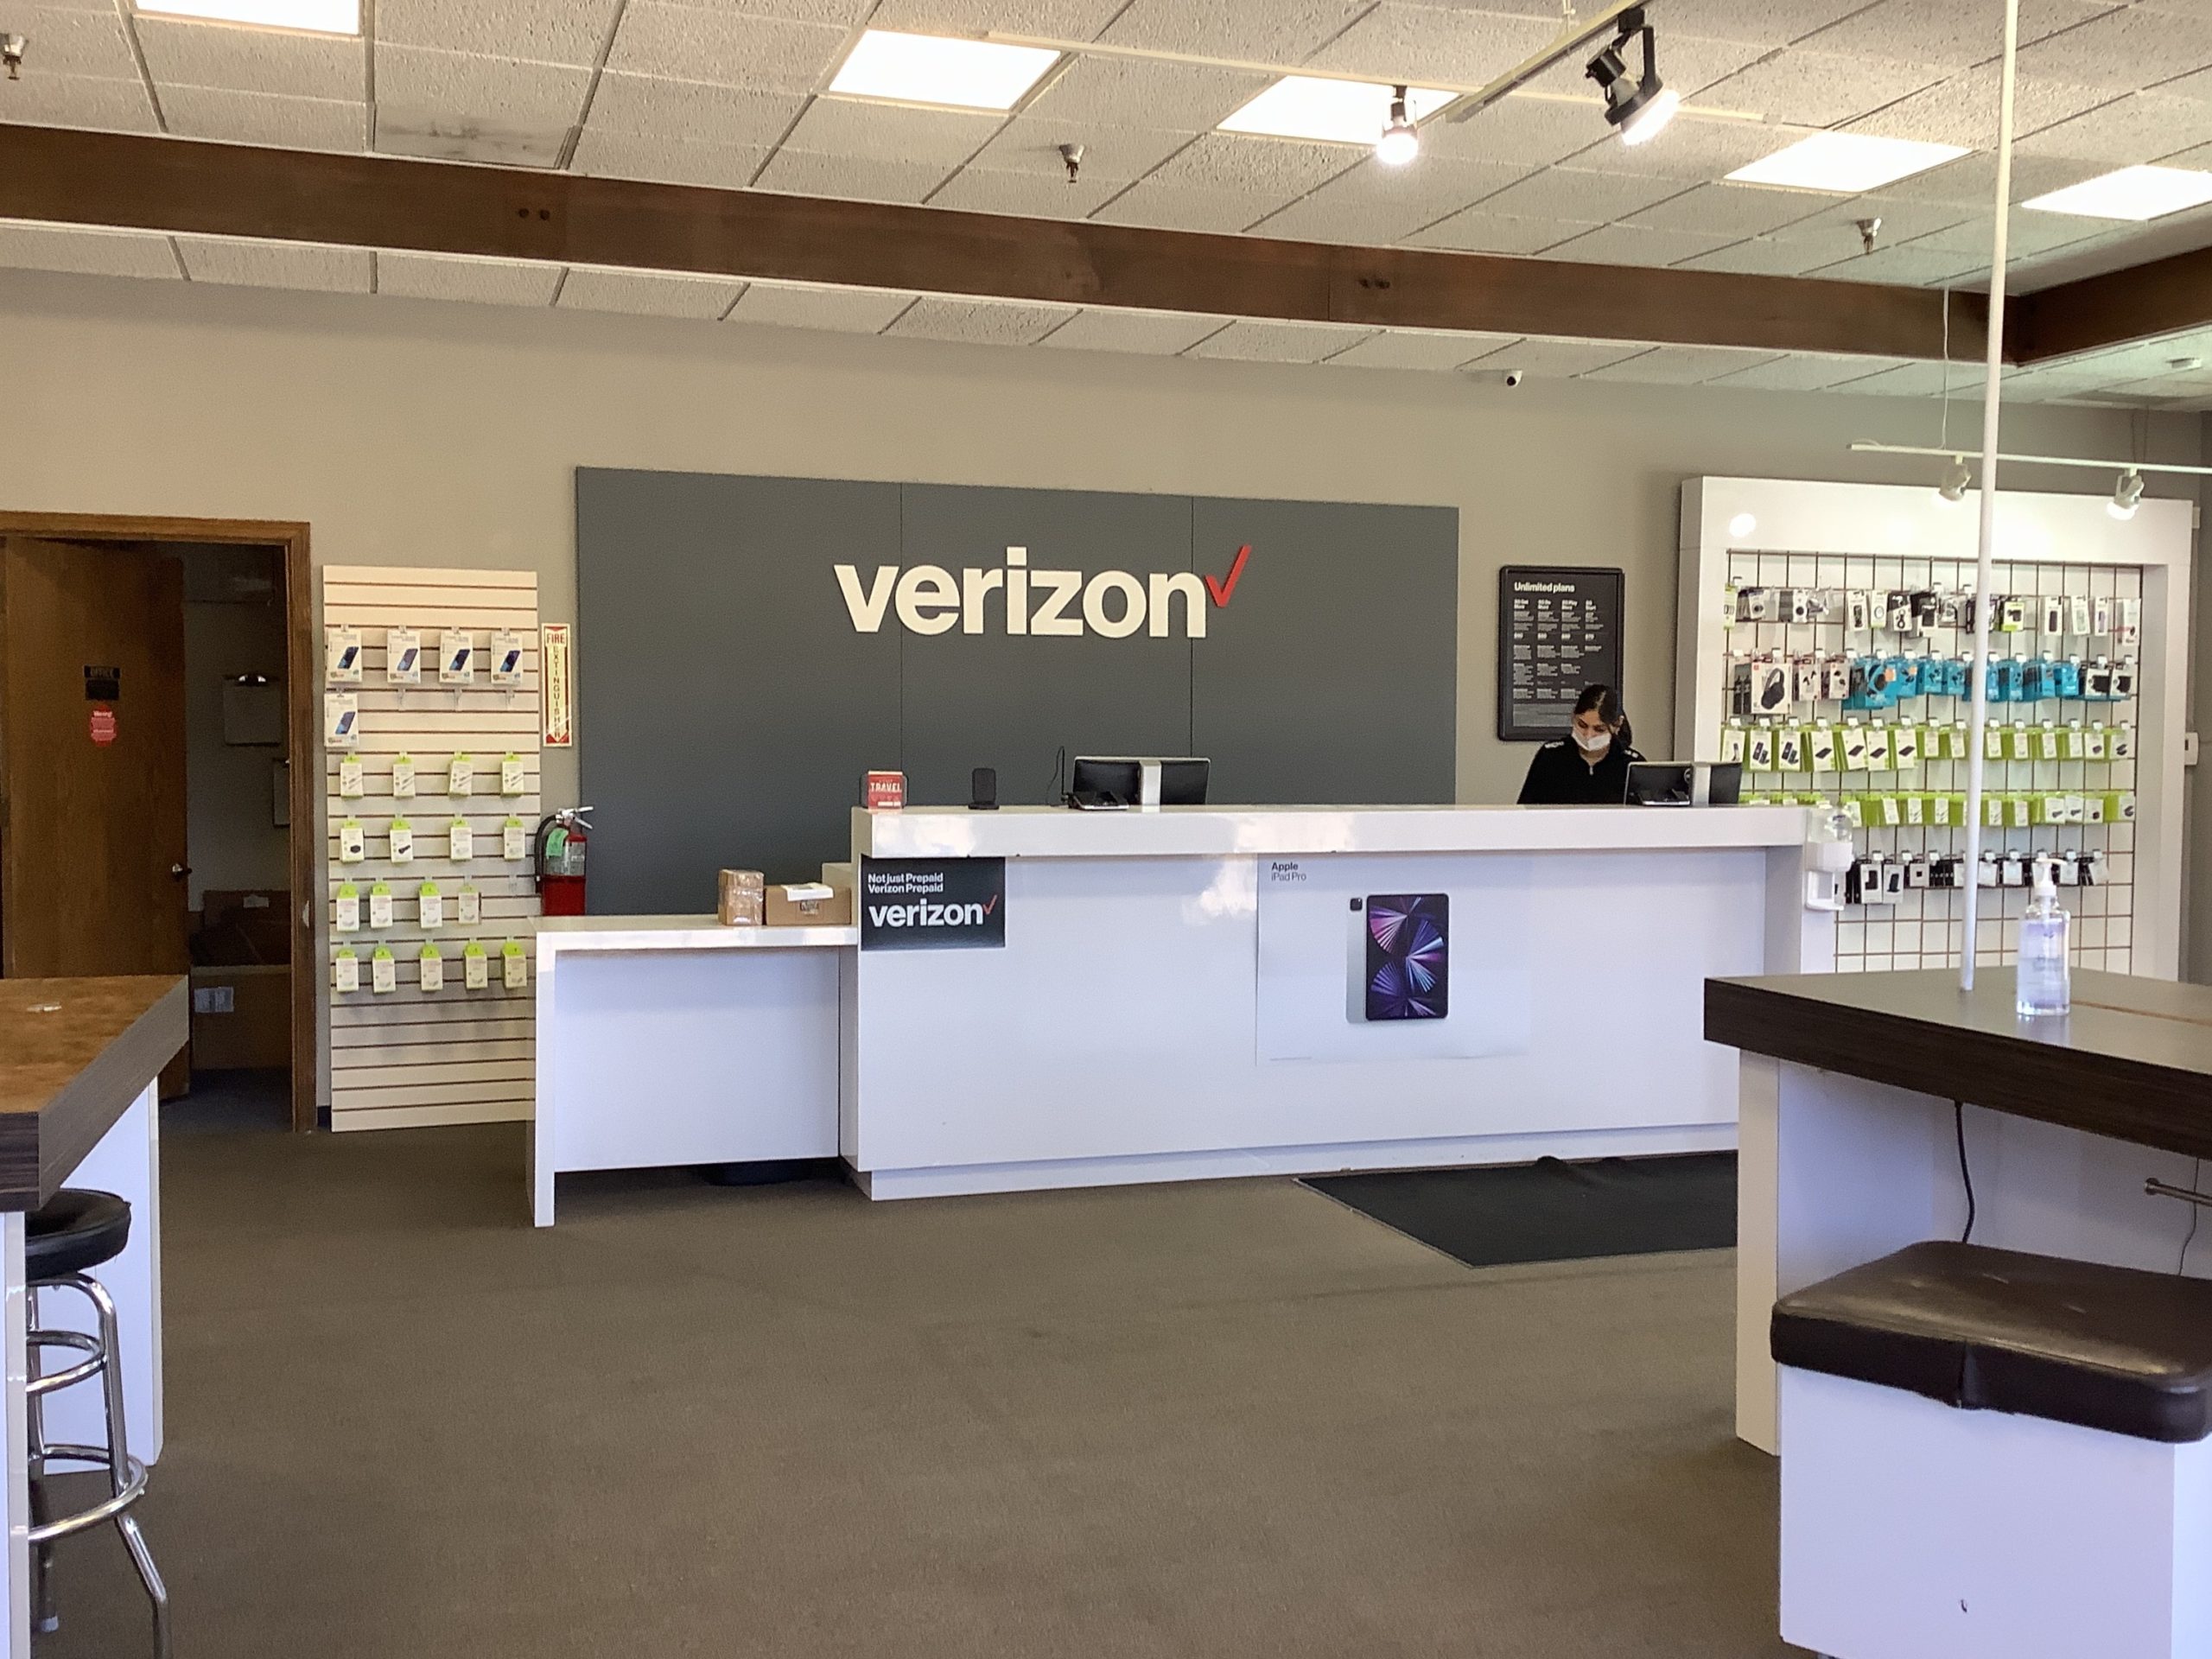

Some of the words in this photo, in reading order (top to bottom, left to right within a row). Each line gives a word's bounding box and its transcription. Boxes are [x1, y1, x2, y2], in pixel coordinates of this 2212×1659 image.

[833, 546, 1207, 639] verizon
[1514, 582, 1553, 592] Unlimited
[1553, 582, 1575, 594] plans
[546, 632, 566, 645] FIRE
[870, 782, 901, 792] TRAVEL
[1271, 861, 1299, 872] Apple
[868, 873, 886, 883] Not
[886, 874, 905, 885] just
[906, 872, 944, 884] Prepaid
[1271, 872, 1290, 881] iPad
[1291, 872, 1307, 881] Pro
[868, 883, 905, 893] Verizon
[906, 882, 944, 894] Prepaid
[868, 898, 983, 927] verizon
